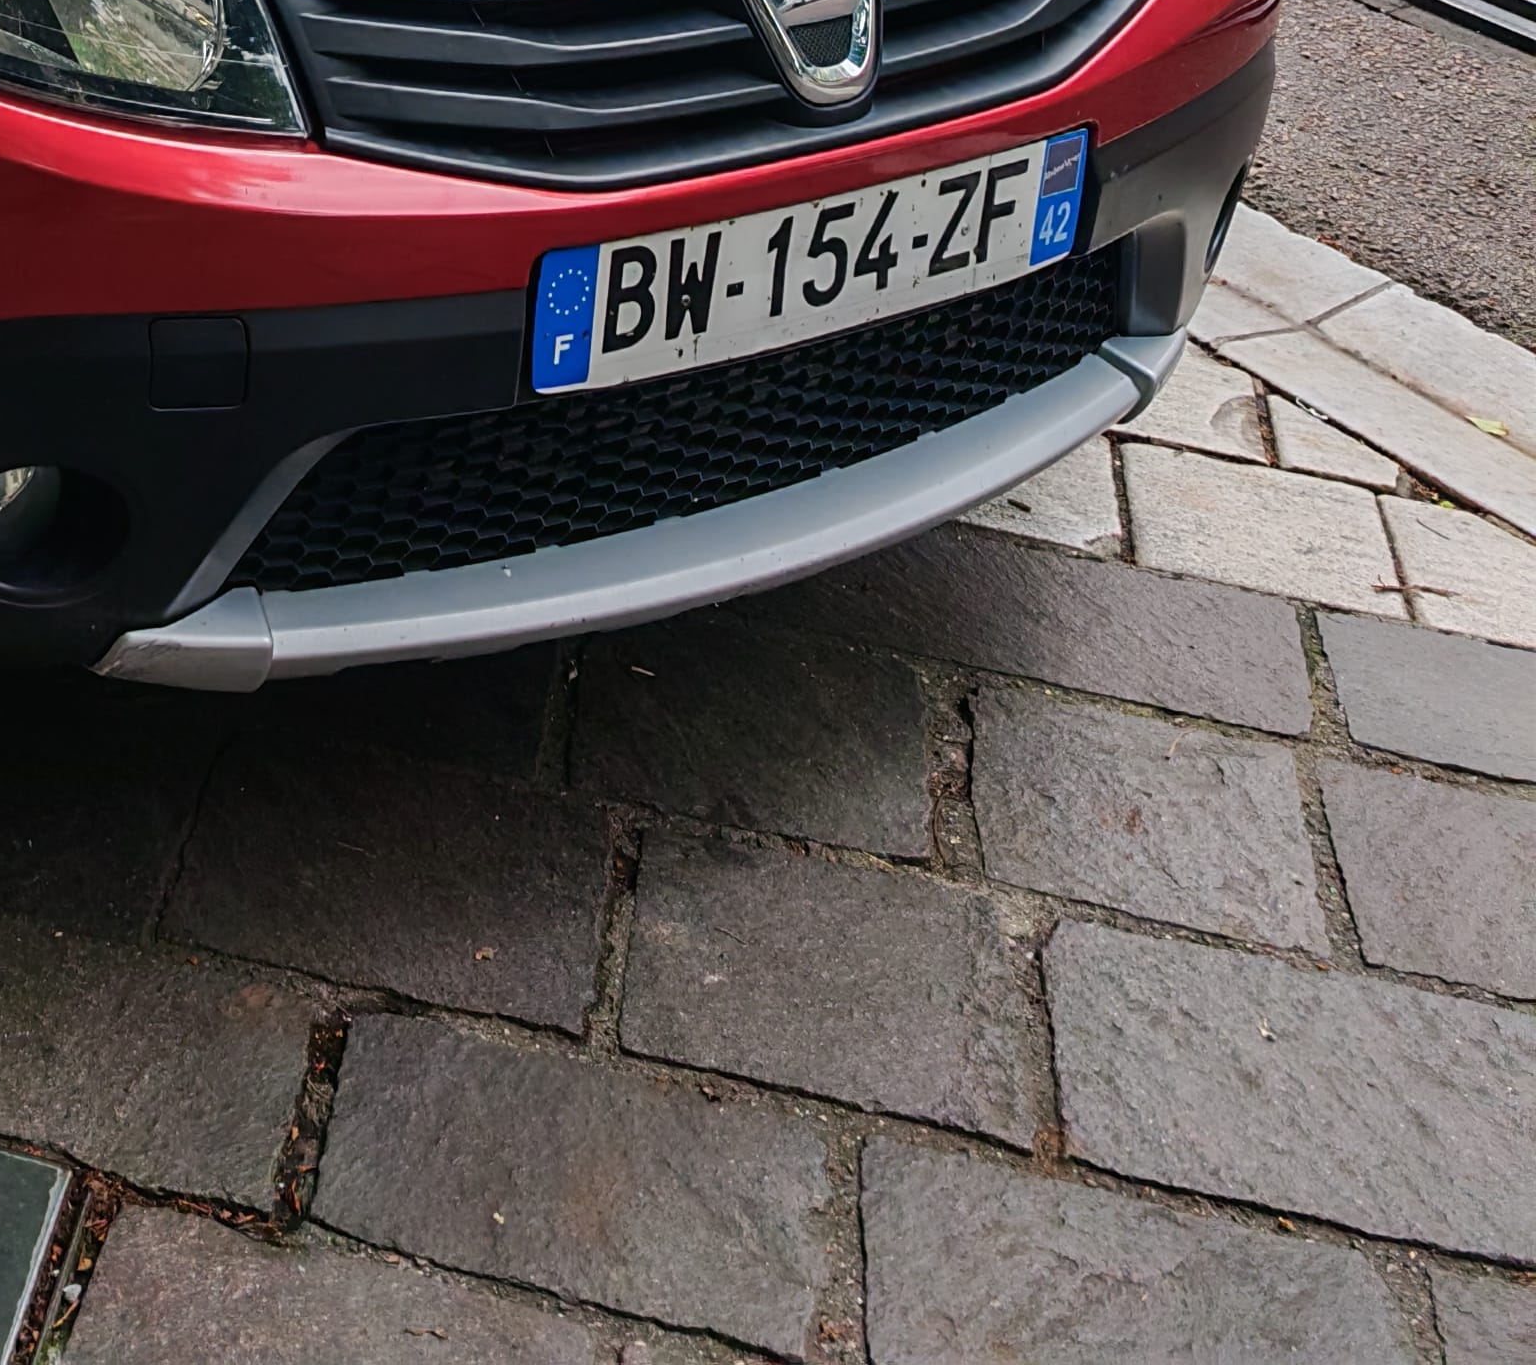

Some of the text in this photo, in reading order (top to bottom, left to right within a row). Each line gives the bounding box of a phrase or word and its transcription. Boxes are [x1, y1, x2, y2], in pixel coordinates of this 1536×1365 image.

[1038, 200, 1071, 246] 42
[601, 158, 1029, 354] BW-154-ZF
[553, 333, 574, 366] F
